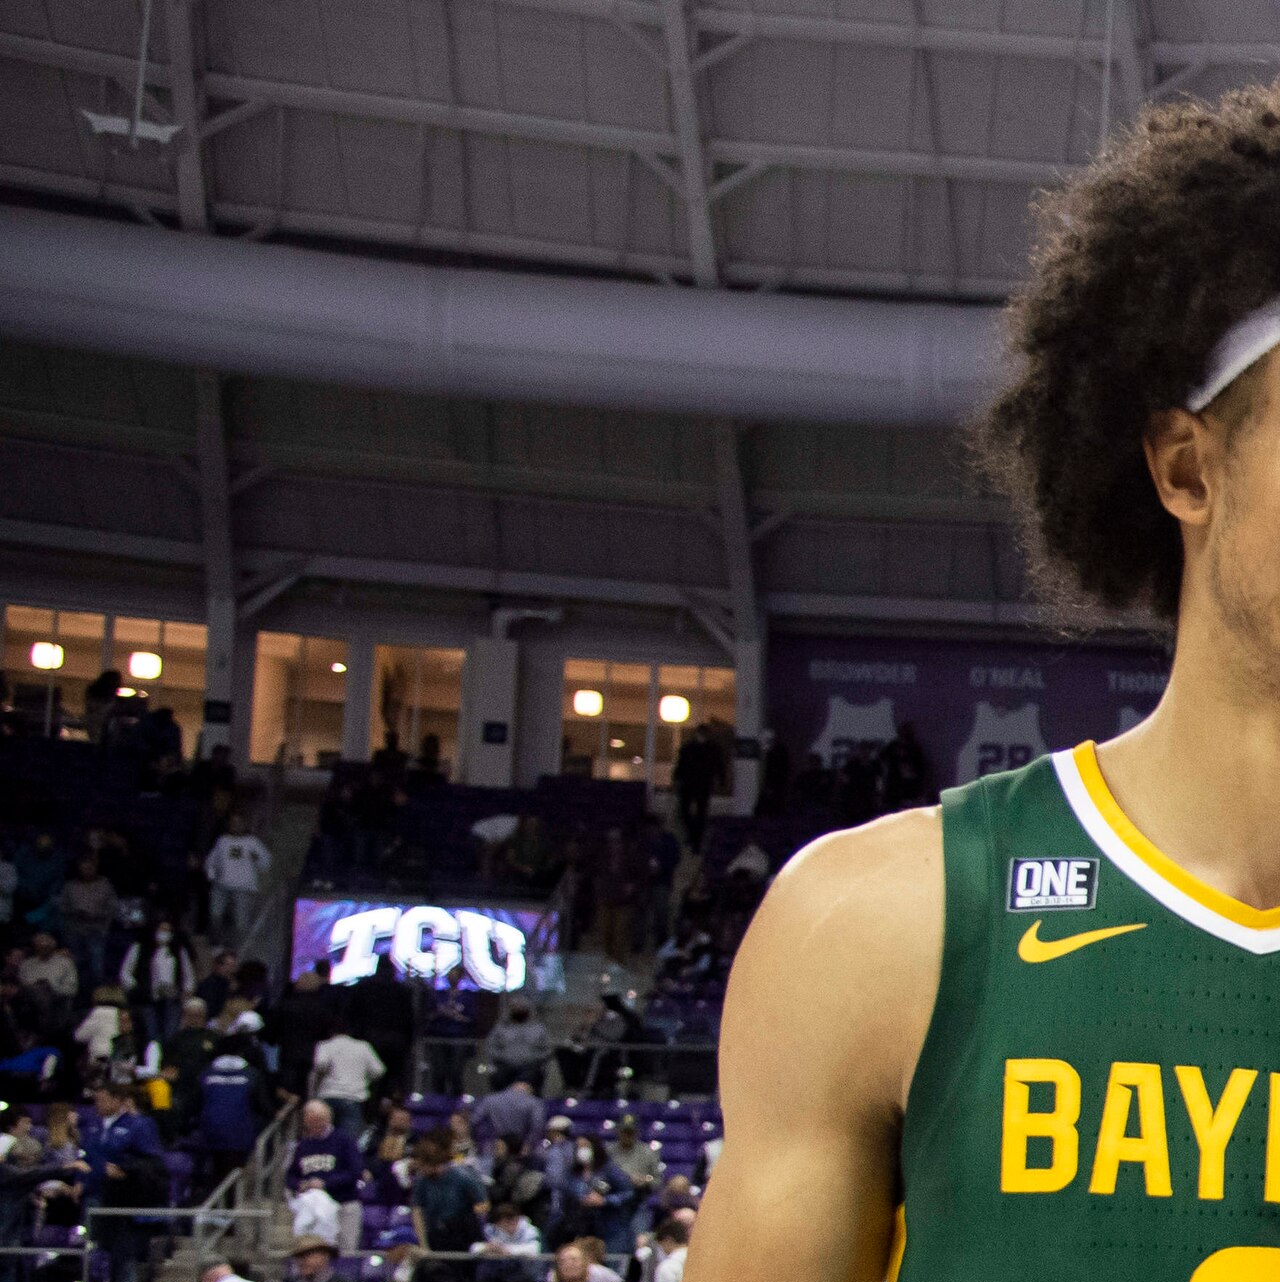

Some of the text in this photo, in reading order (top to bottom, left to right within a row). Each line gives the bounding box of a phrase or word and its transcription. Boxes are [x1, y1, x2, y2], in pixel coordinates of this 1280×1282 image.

[809, 659, 918, 684] BROWDER
[969, 666, 1046, 690] O'NEAL
[1016, 861, 1091, 897] ONE
[327, 906, 526, 993] TCU
